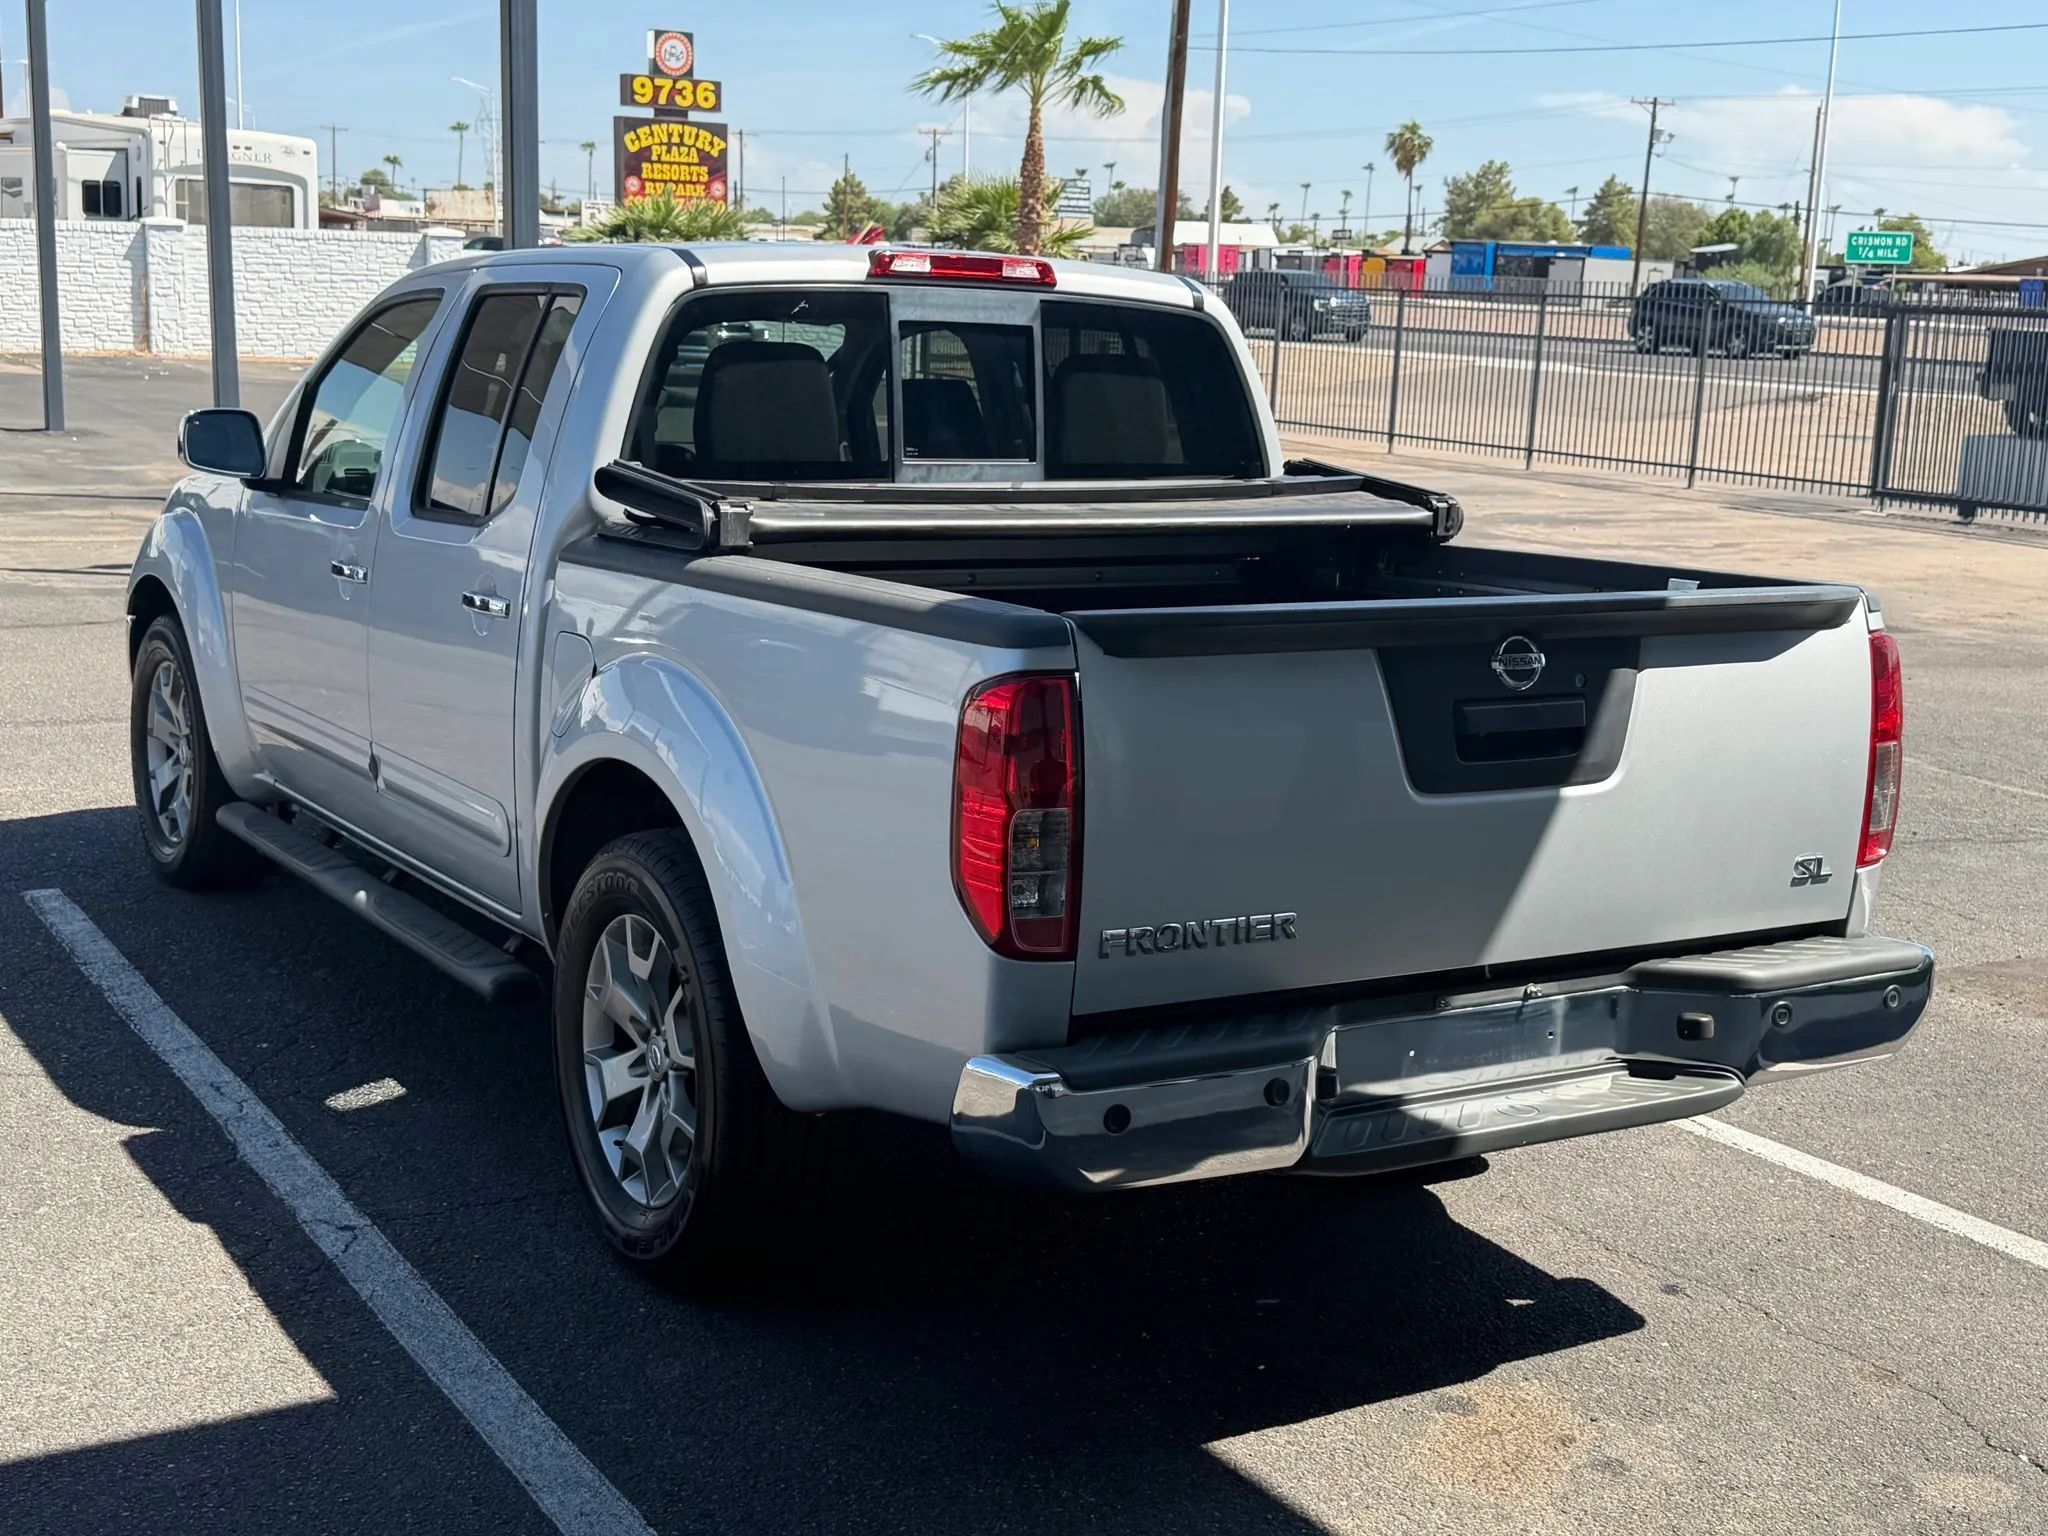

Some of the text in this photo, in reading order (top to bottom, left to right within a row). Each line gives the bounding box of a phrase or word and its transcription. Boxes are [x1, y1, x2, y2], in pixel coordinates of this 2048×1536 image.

[632, 76, 717, 109] 9736
[624, 123, 727, 158] CENTURY
[651, 146, 699, 163] PLAZA
[641, 162, 709, 181] RESORTS
[645, 181, 665, 195] RV
[1851, 236, 1908, 246] CRISMON RD
[1877, 248, 1899, 258] MILE
[1498, 656, 1542, 667] NISSAN
[1791, 853, 1833, 883] SL
[1099, 912, 1299, 958] FRONTIER
